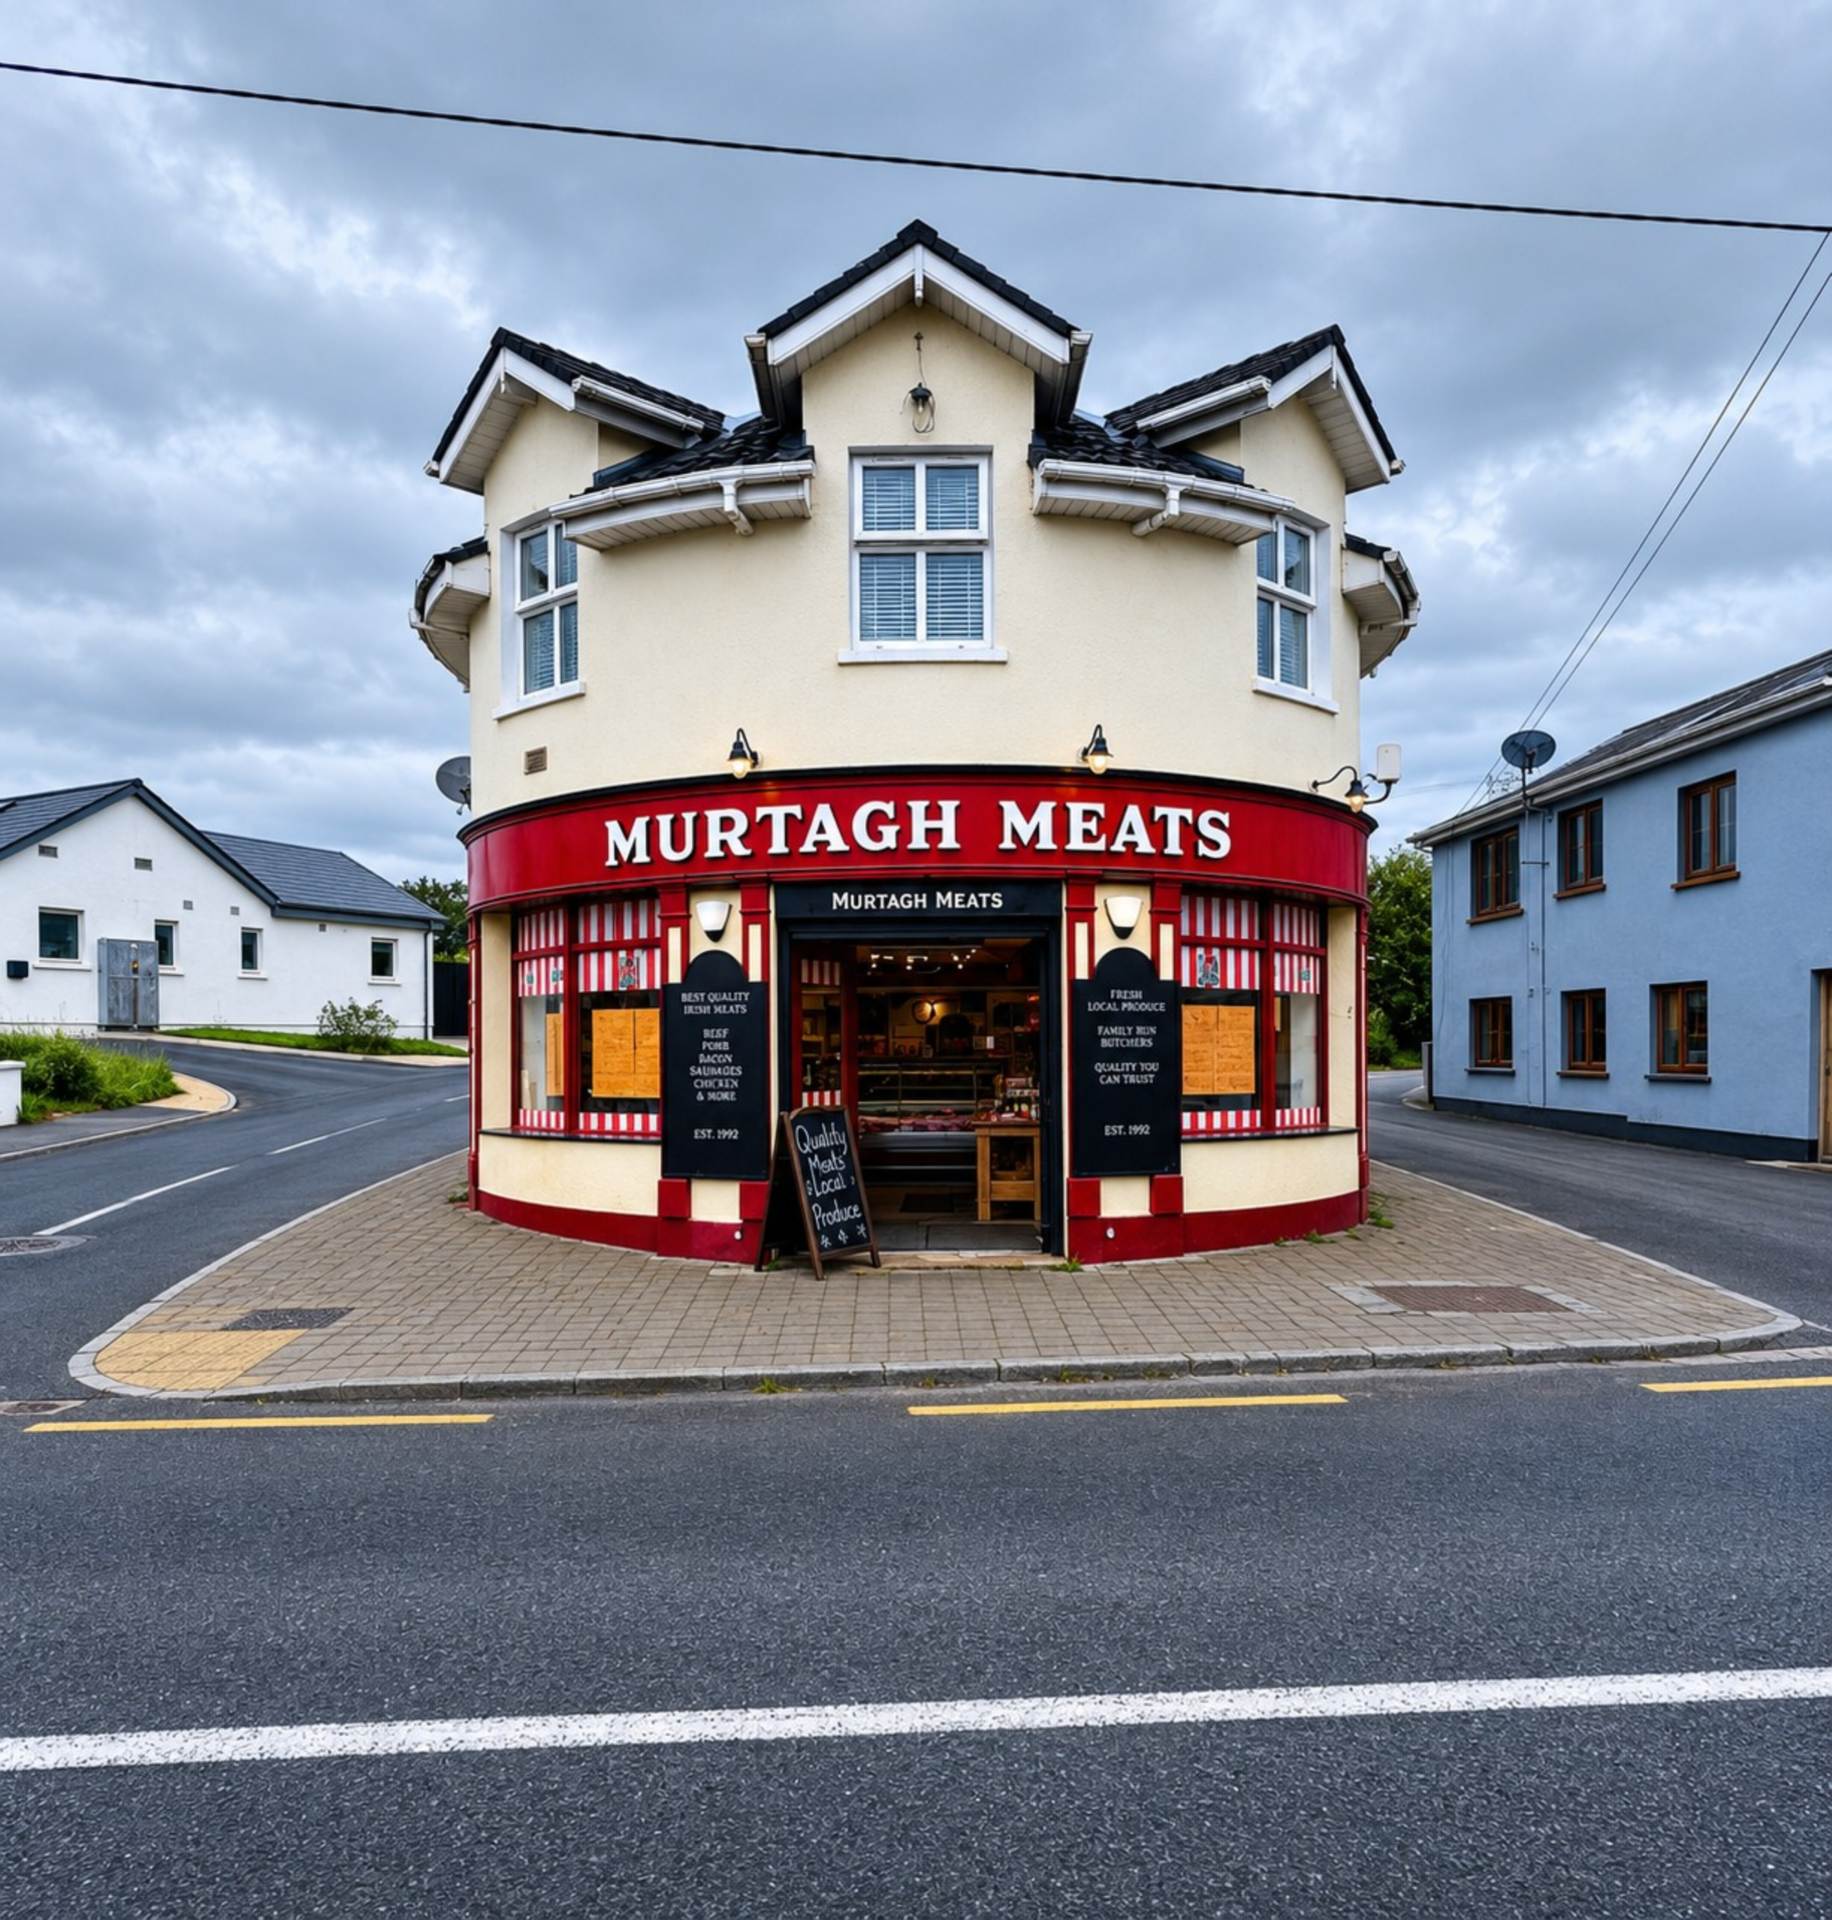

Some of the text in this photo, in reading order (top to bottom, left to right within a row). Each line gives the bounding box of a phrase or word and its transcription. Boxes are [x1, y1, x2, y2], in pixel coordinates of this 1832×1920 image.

[604, 800, 1232, 867] MURTAGH MEATS
[832, 891, 1004, 910] MURTAGH MEATS
[681, 991, 750, 1003] BEST QUALITY
[1110, 989, 1143, 1000] FRESH
[713, 1004, 748, 1014] MEATS
[1087, 1002, 1166, 1012] LOCAL PRODUCE
[1097, 1025, 1133, 1036] FAMILY
[1100, 1038, 1153, 1048] BUTCHERS
[1094, 1062, 1159, 1073] QUALITY YOU
[1099, 1074, 1155, 1085] CAN TRUST
[707, 1091, 737, 1101] MORE
[693, 1128, 739, 1140] EST. 1992
[1104, 1124, 1151, 1136] EST. 1992
[795, 1122, 848, 1155] Quality
[811, 1172, 847, 1198] Local
[811, 1199, 862, 1231] Produce
